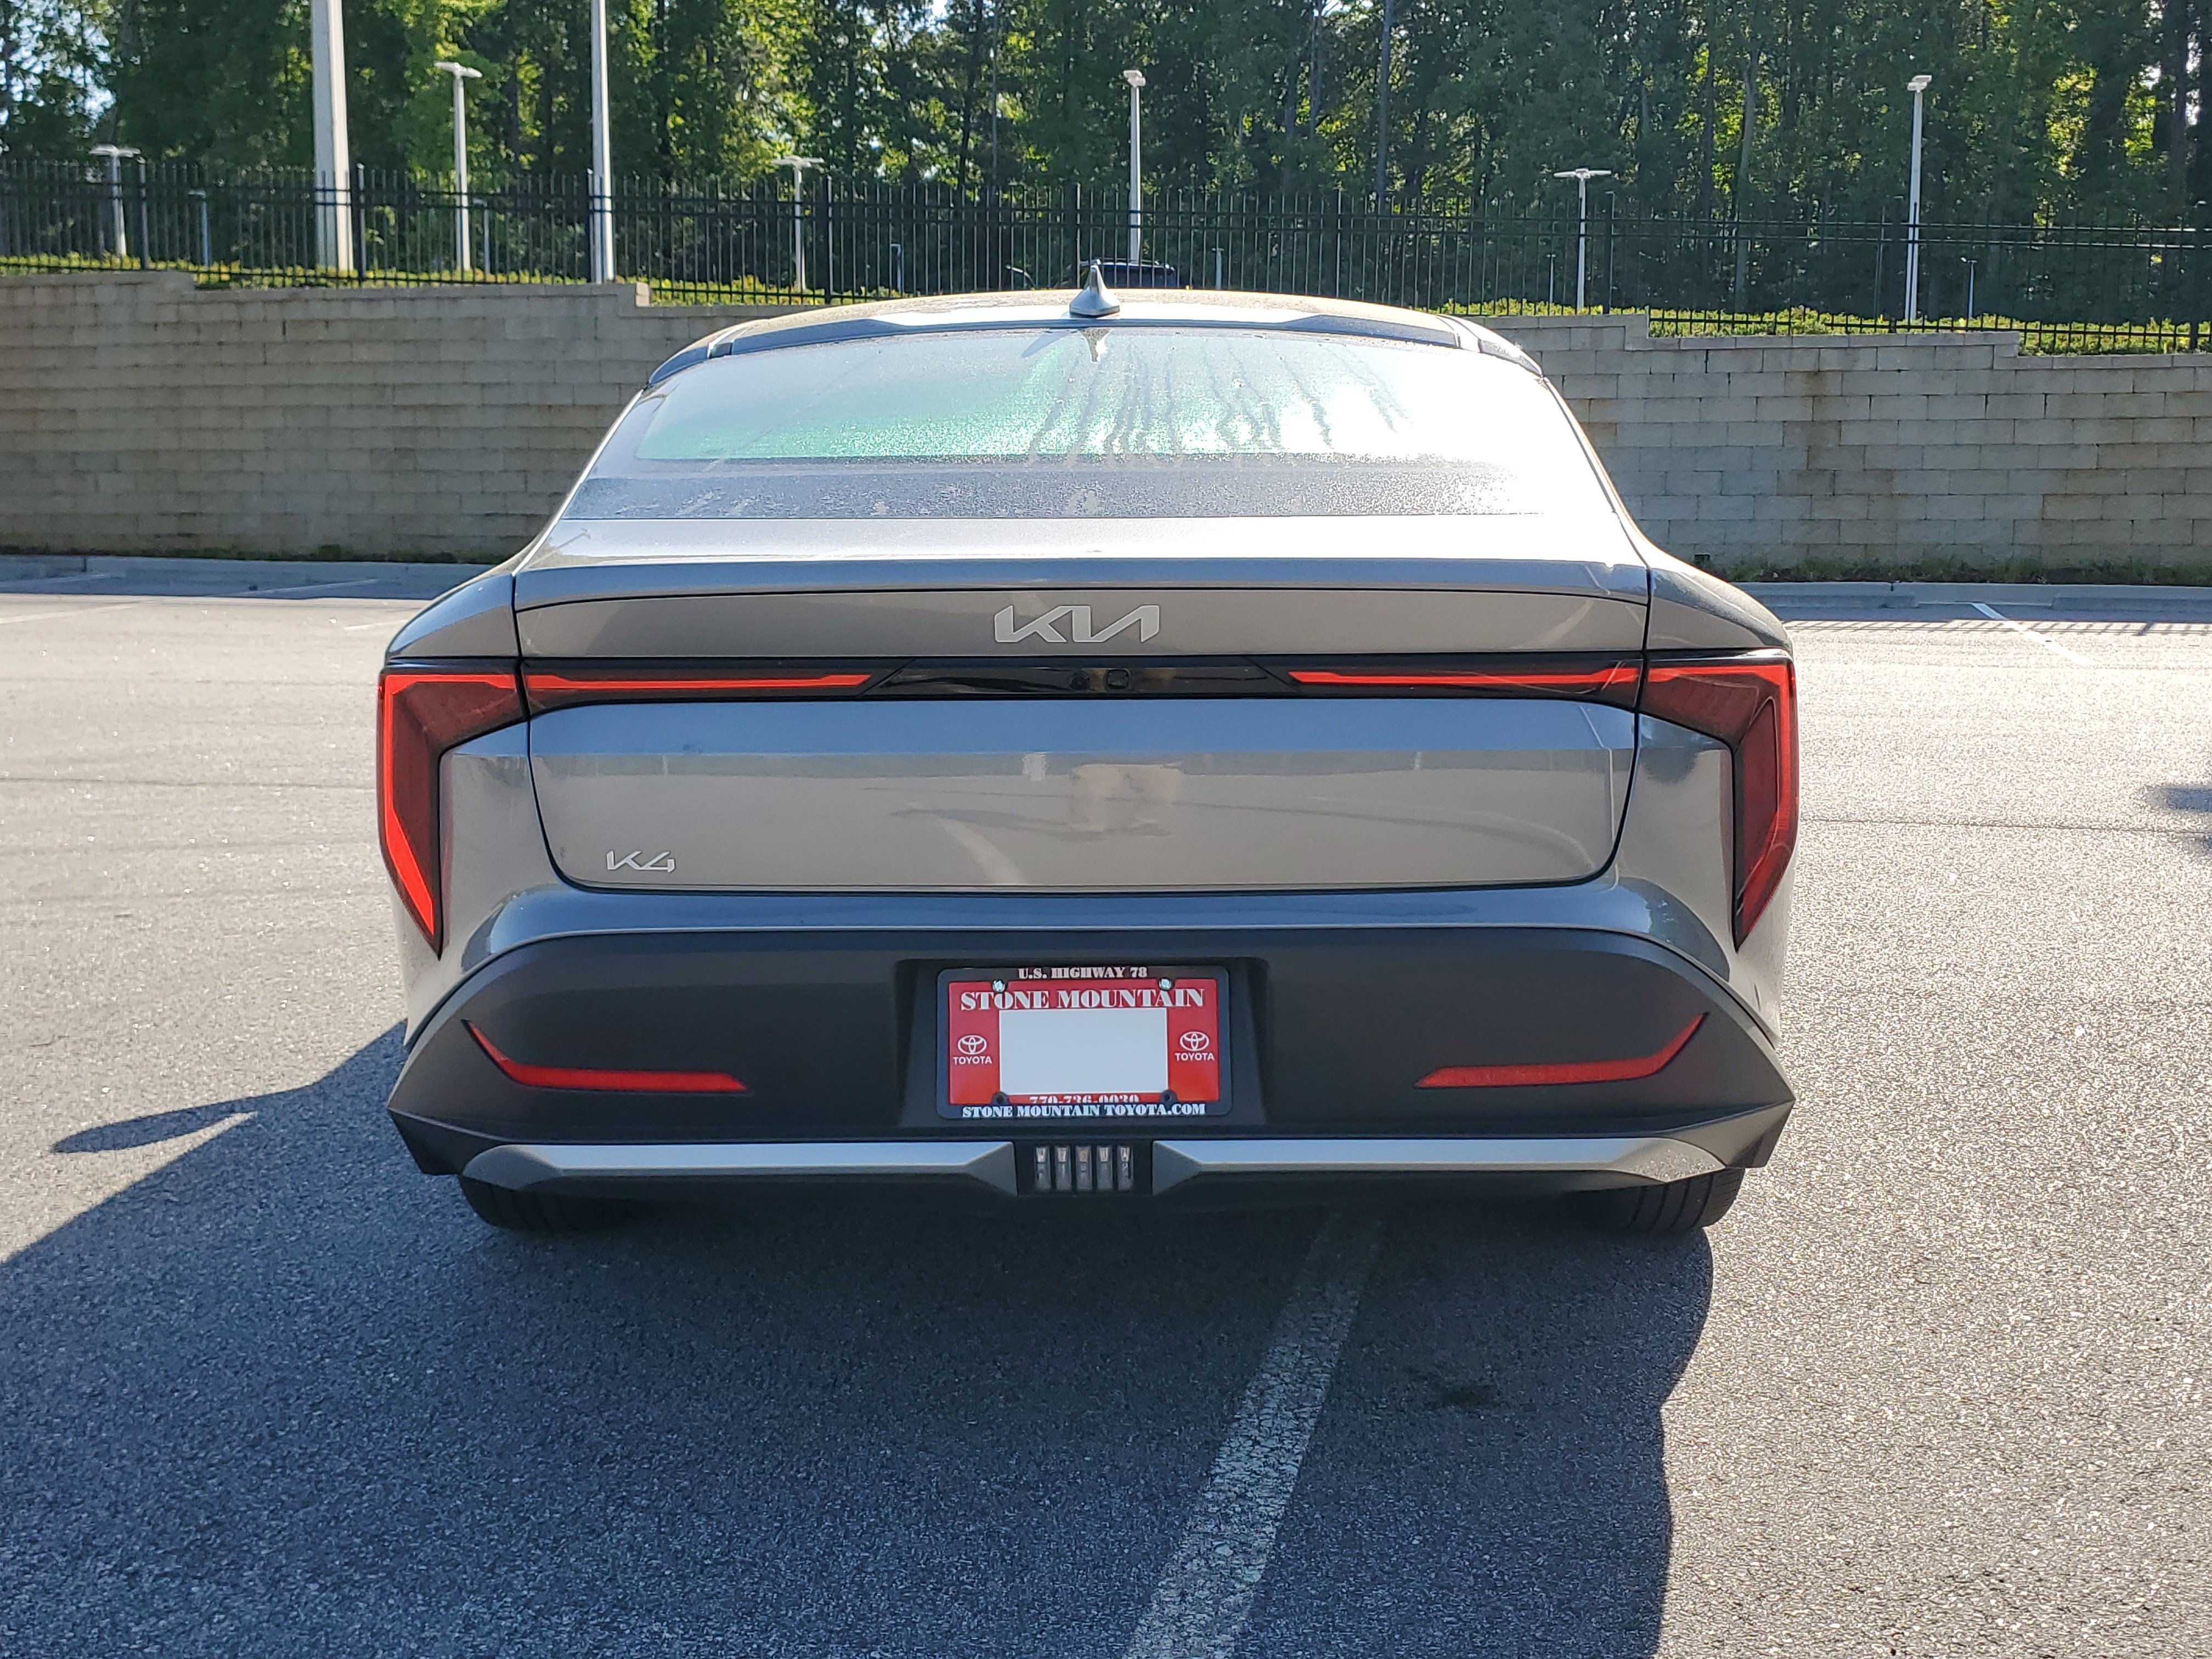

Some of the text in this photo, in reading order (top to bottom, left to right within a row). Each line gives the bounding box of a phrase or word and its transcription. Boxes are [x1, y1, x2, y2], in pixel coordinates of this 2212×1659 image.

[994, 605, 1160, 643] KIA
[606, 850, 675, 873] K4
[1018, 967, 1148, 979] U.S. HIGHWAY 78
[960, 988, 1205, 1011] STONE MOUNTAIN
[952, 1056, 992, 1065] TOYOTA
[1175, 1052, 1215, 1062] TOYOTA
[962, 1103, 1206, 1118] STONE MOUNTAIN TOYOTA.COM
